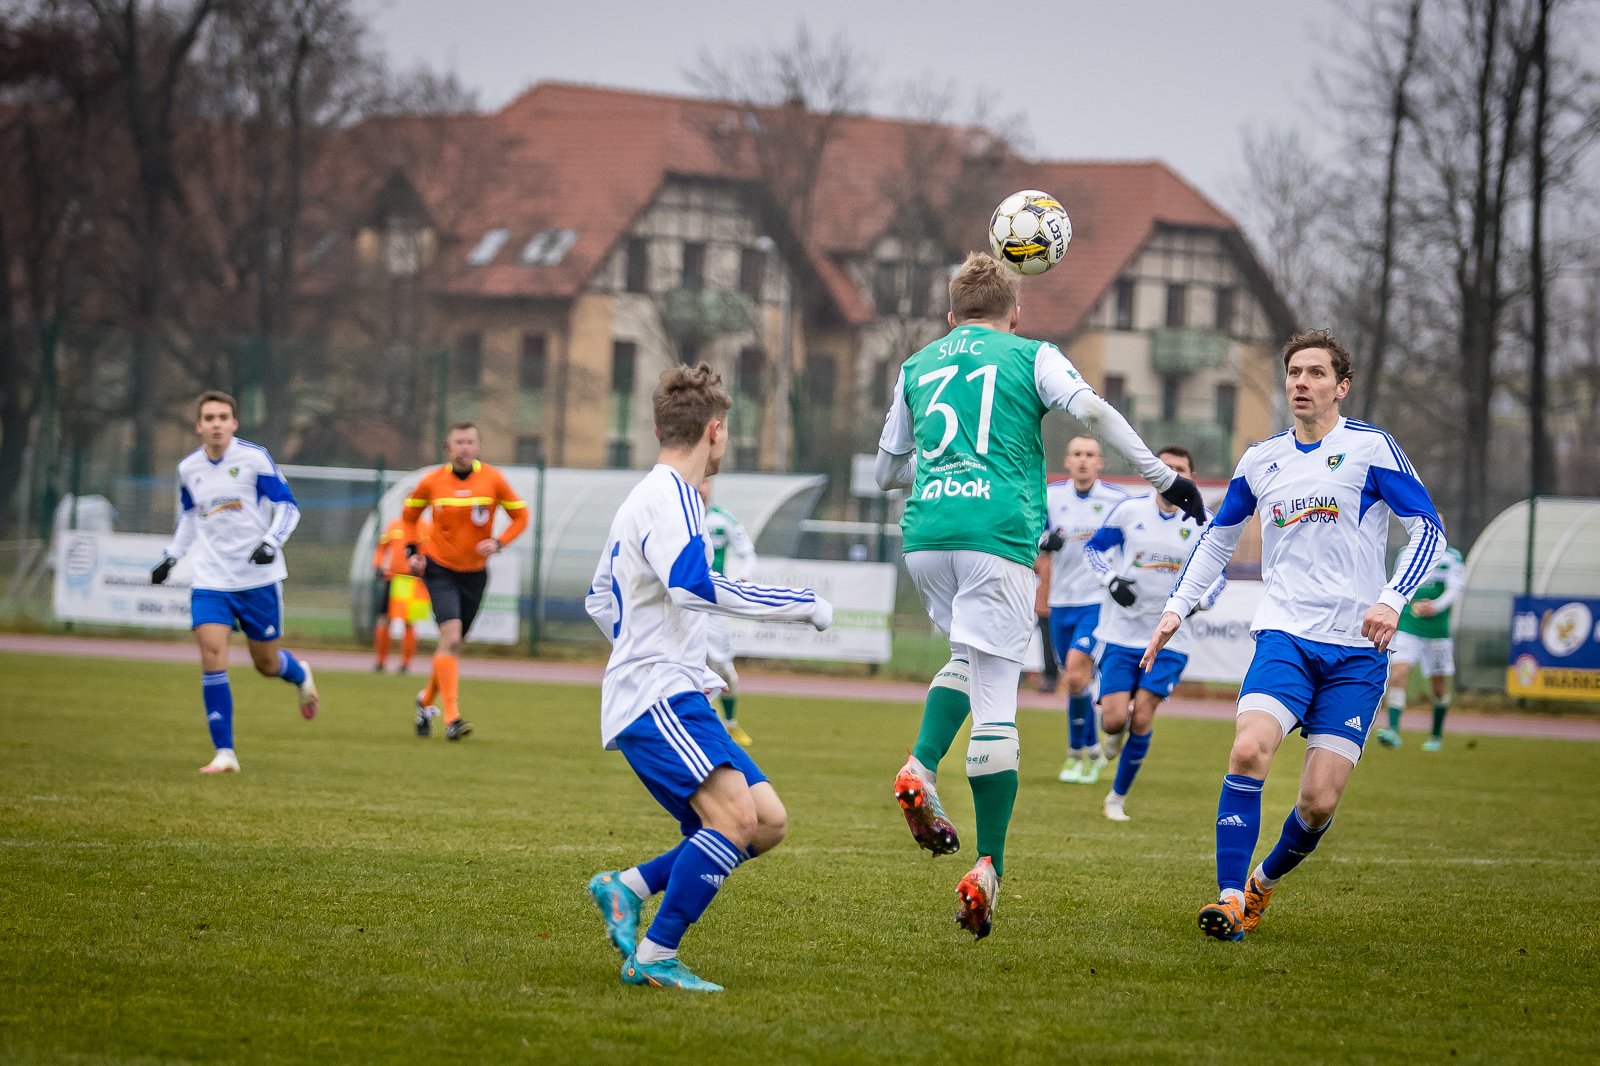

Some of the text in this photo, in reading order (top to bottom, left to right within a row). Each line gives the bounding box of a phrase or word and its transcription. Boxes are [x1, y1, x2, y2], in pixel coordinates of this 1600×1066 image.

[1047, 219, 1065, 260] SELECT
[938, 338, 985, 360] SULC
[917, 364, 998, 460] 31
[1290, 496, 1338, 513] JELENIA
